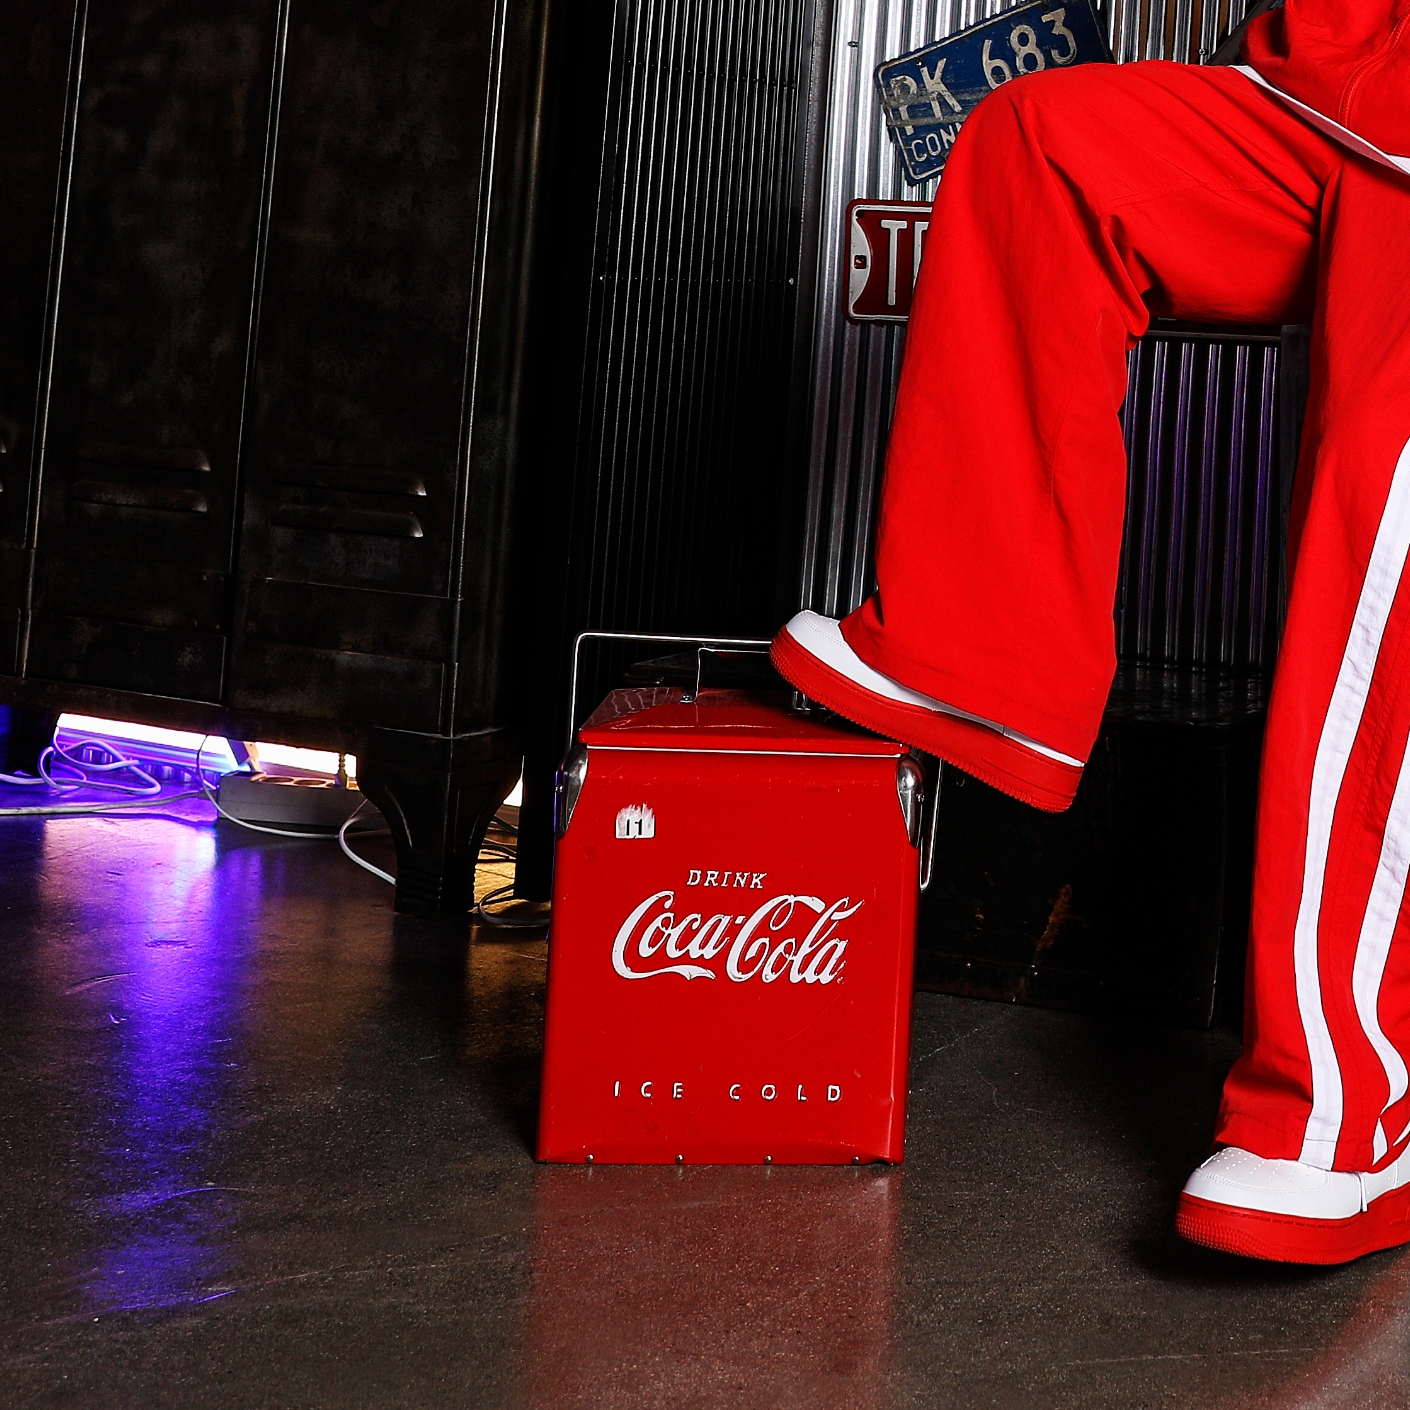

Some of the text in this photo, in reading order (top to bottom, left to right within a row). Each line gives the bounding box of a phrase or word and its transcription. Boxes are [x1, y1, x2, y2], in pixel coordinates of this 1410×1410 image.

[981, 7, 1078, 91] 683
[911, 122, 962, 162] CON
[687, 869, 767, 889] DRINK
[611, 890, 865, 985] Coca-Cola
[612, 1080, 842, 1102] ICE COLD
